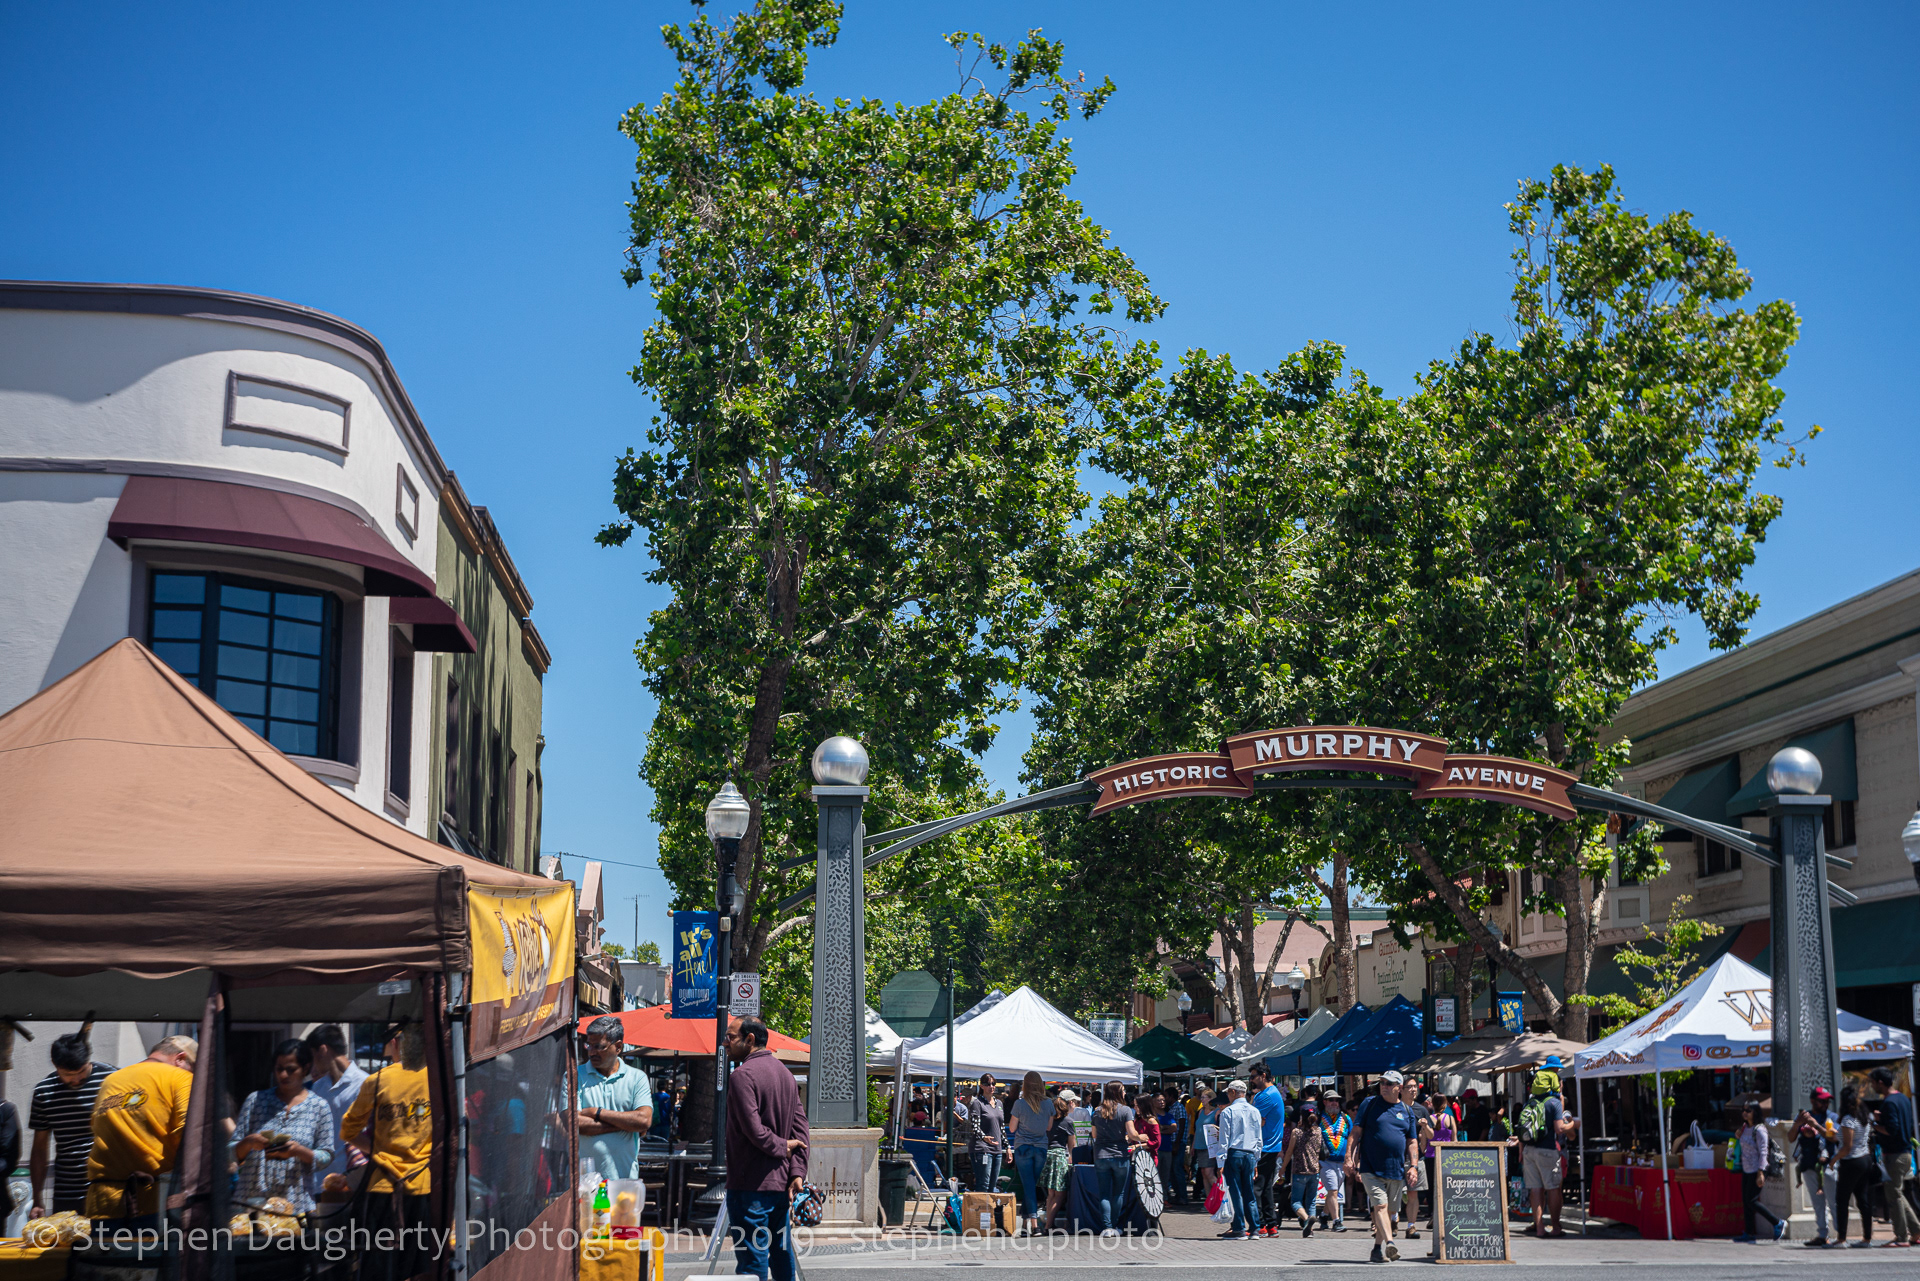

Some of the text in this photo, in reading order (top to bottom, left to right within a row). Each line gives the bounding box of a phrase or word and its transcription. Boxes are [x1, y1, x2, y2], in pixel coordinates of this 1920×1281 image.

[1113, 733, 1547, 793] HISTORIC MURPHY AVENUE
[680, 927, 712, 946] It's
[679, 942, 703, 962] all
[676, 947, 713, 987] Here!
[678, 992, 710, 1008] Sunnyvale
[1501, 1001, 1520, 1012] It's
[1502, 1010, 1515, 1021] all
[1442, 1151, 1494, 1168] MARKEGARD
[1446, 1176, 1495, 1194] Regenerative
[1452, 1188, 1492, 1199] Local
[1445, 1212, 1502, 1227] Pasture Raised
